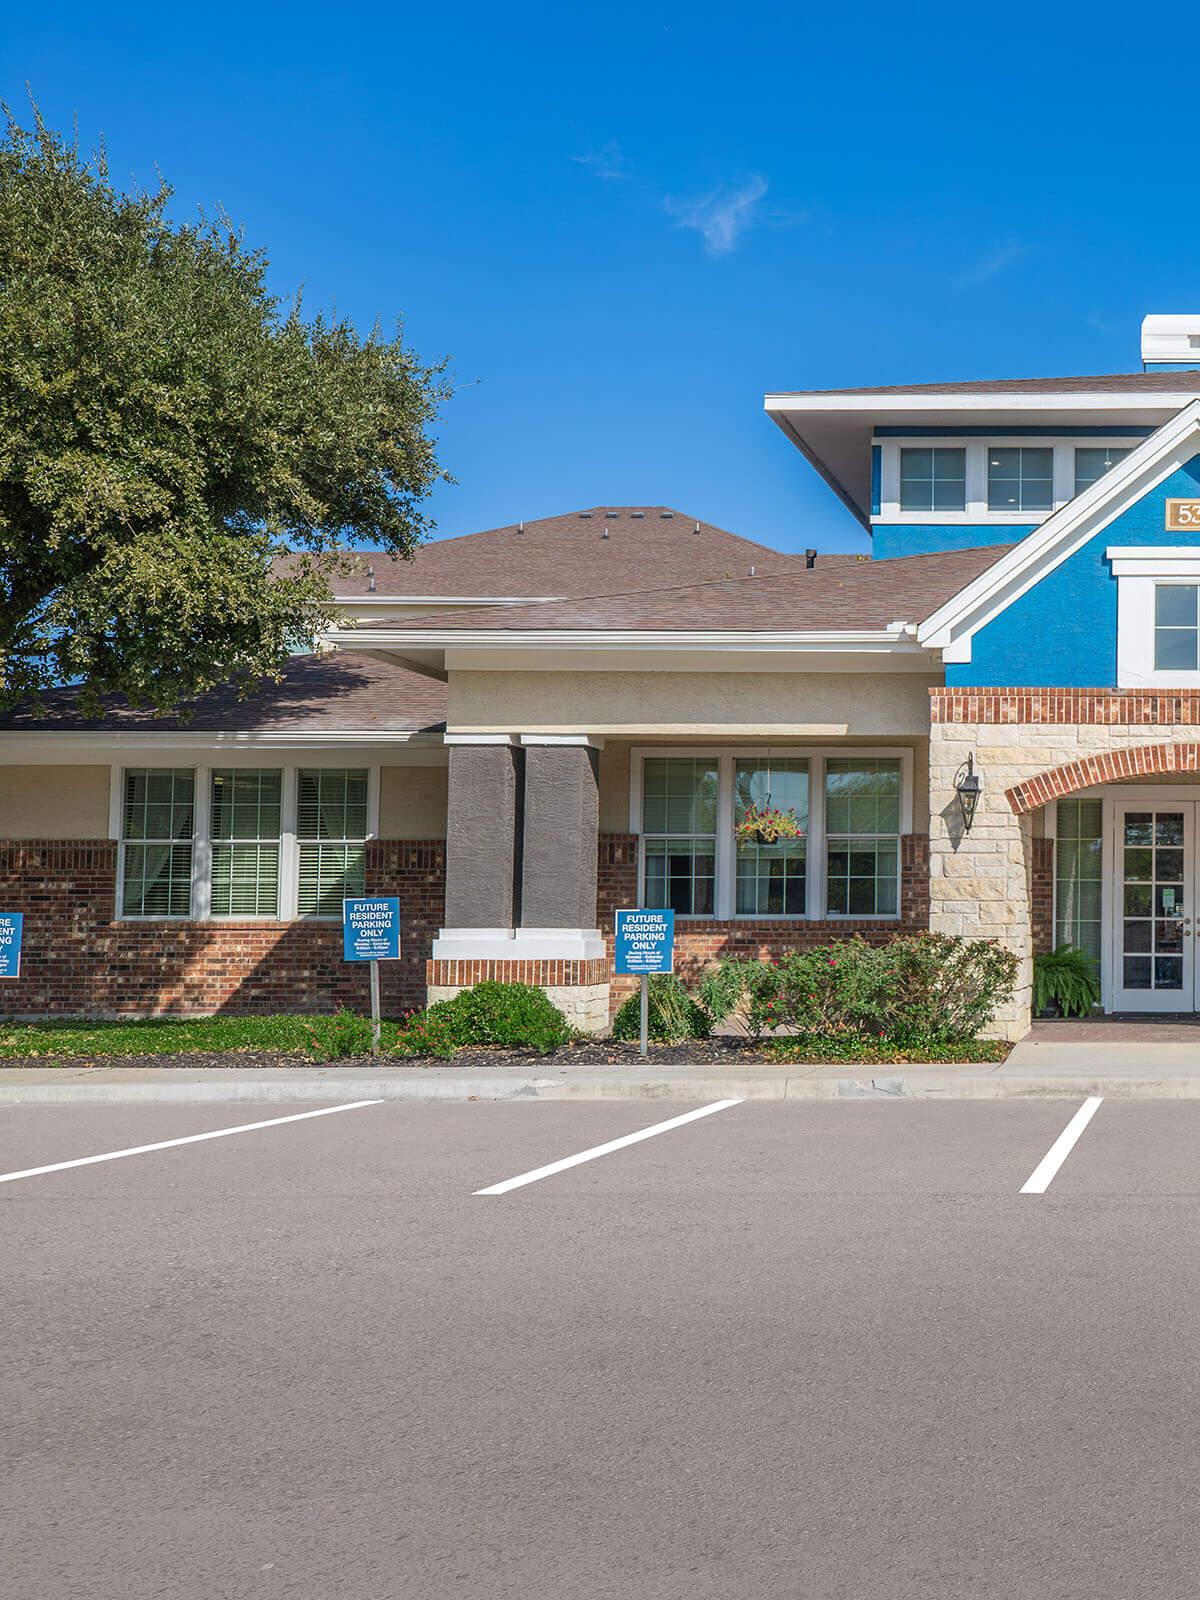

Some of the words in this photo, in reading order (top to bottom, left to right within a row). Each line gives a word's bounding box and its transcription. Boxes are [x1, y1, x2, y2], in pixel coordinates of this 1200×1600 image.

[353, 903, 389, 912] FUTURE
[350, 911, 394, 921] RESIDENT
[626, 914, 664, 923] FUTURE
[352, 920, 392, 929] PARKING
[622, 923, 668, 932] RESIDENT
[360, 929, 384, 937] ONLY
[624, 932, 665, 941] PARKING
[632, 941, 657, 950] ONLY
